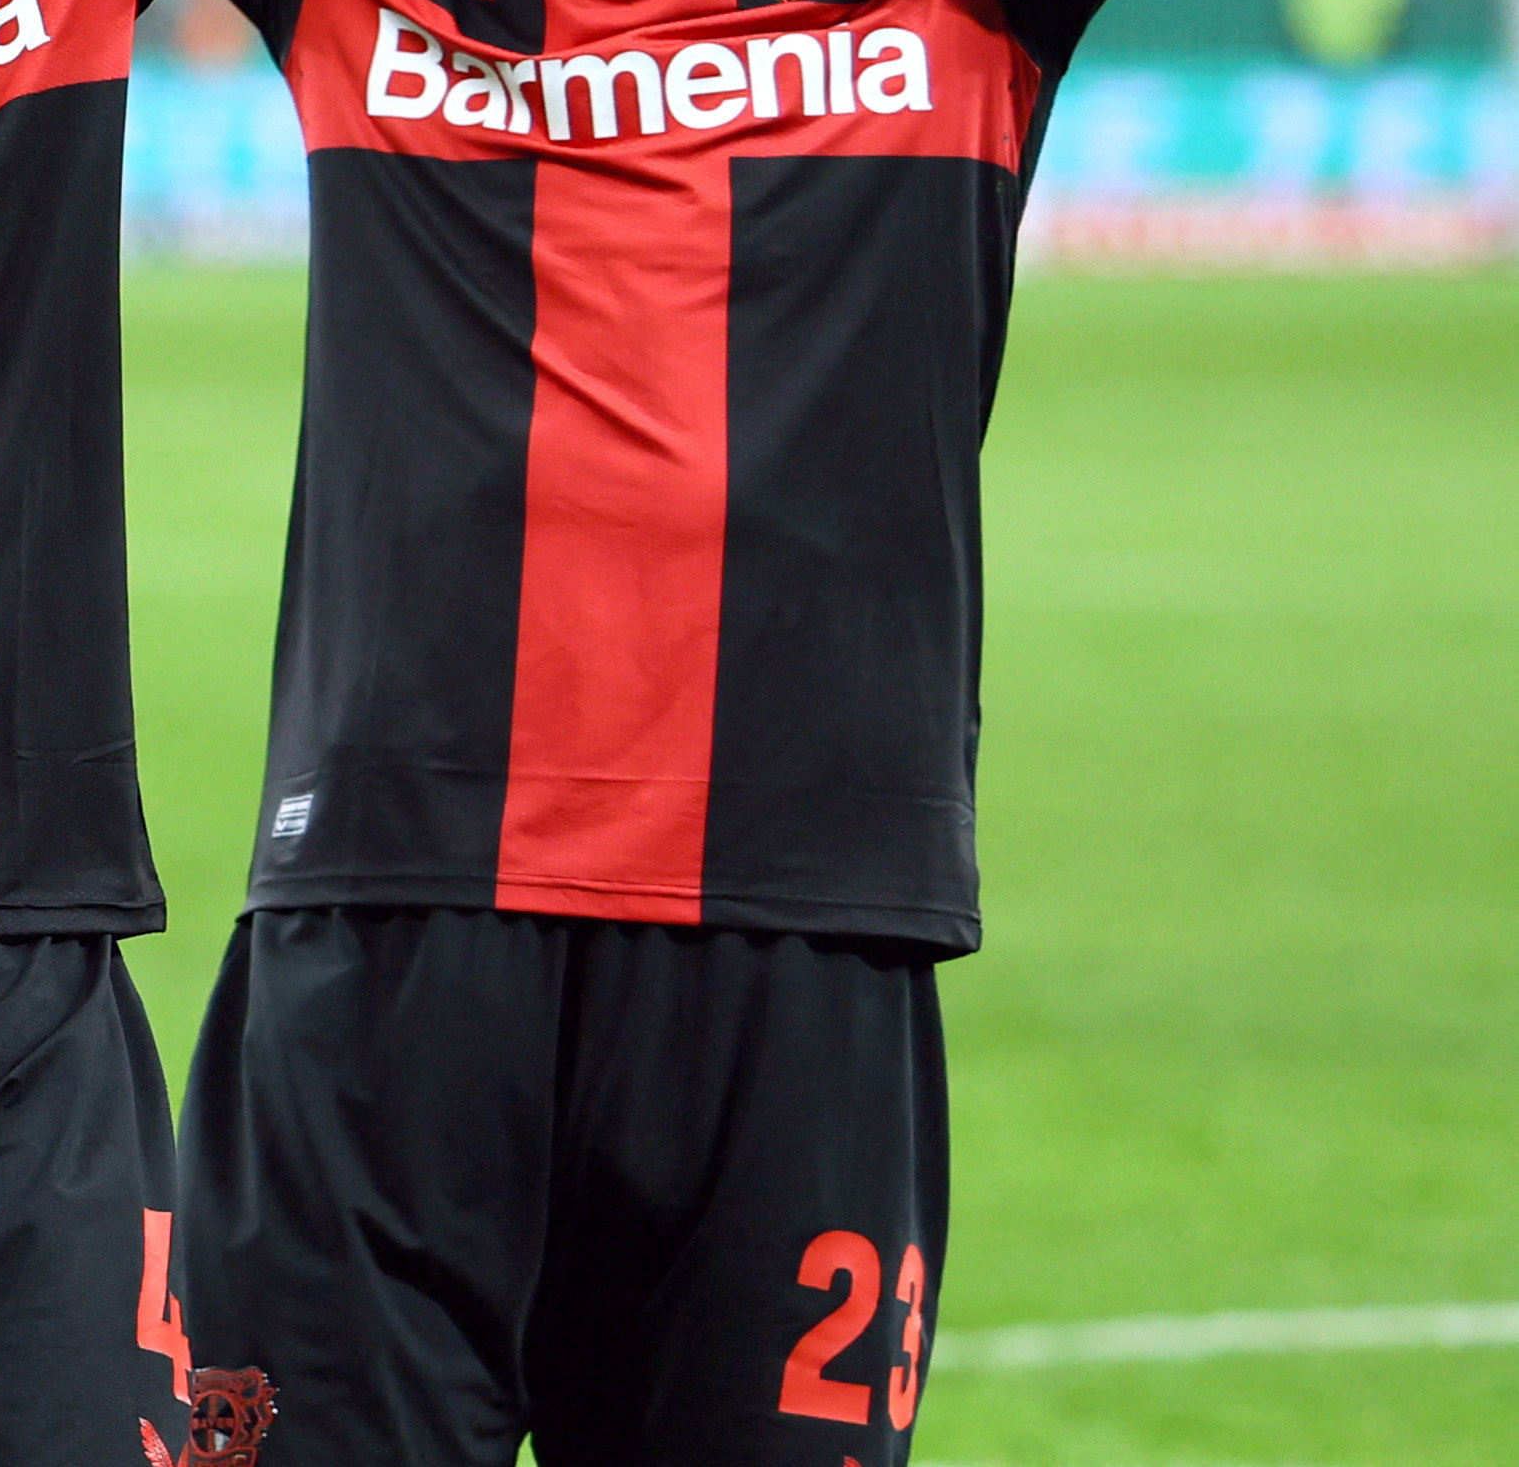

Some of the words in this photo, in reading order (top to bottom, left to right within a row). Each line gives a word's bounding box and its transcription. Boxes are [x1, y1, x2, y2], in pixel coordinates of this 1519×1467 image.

[366, 8, 932, 141] Barmenia
[137, 1208, 192, 1405] 4
[779, 1230, 925, 1431] 23
